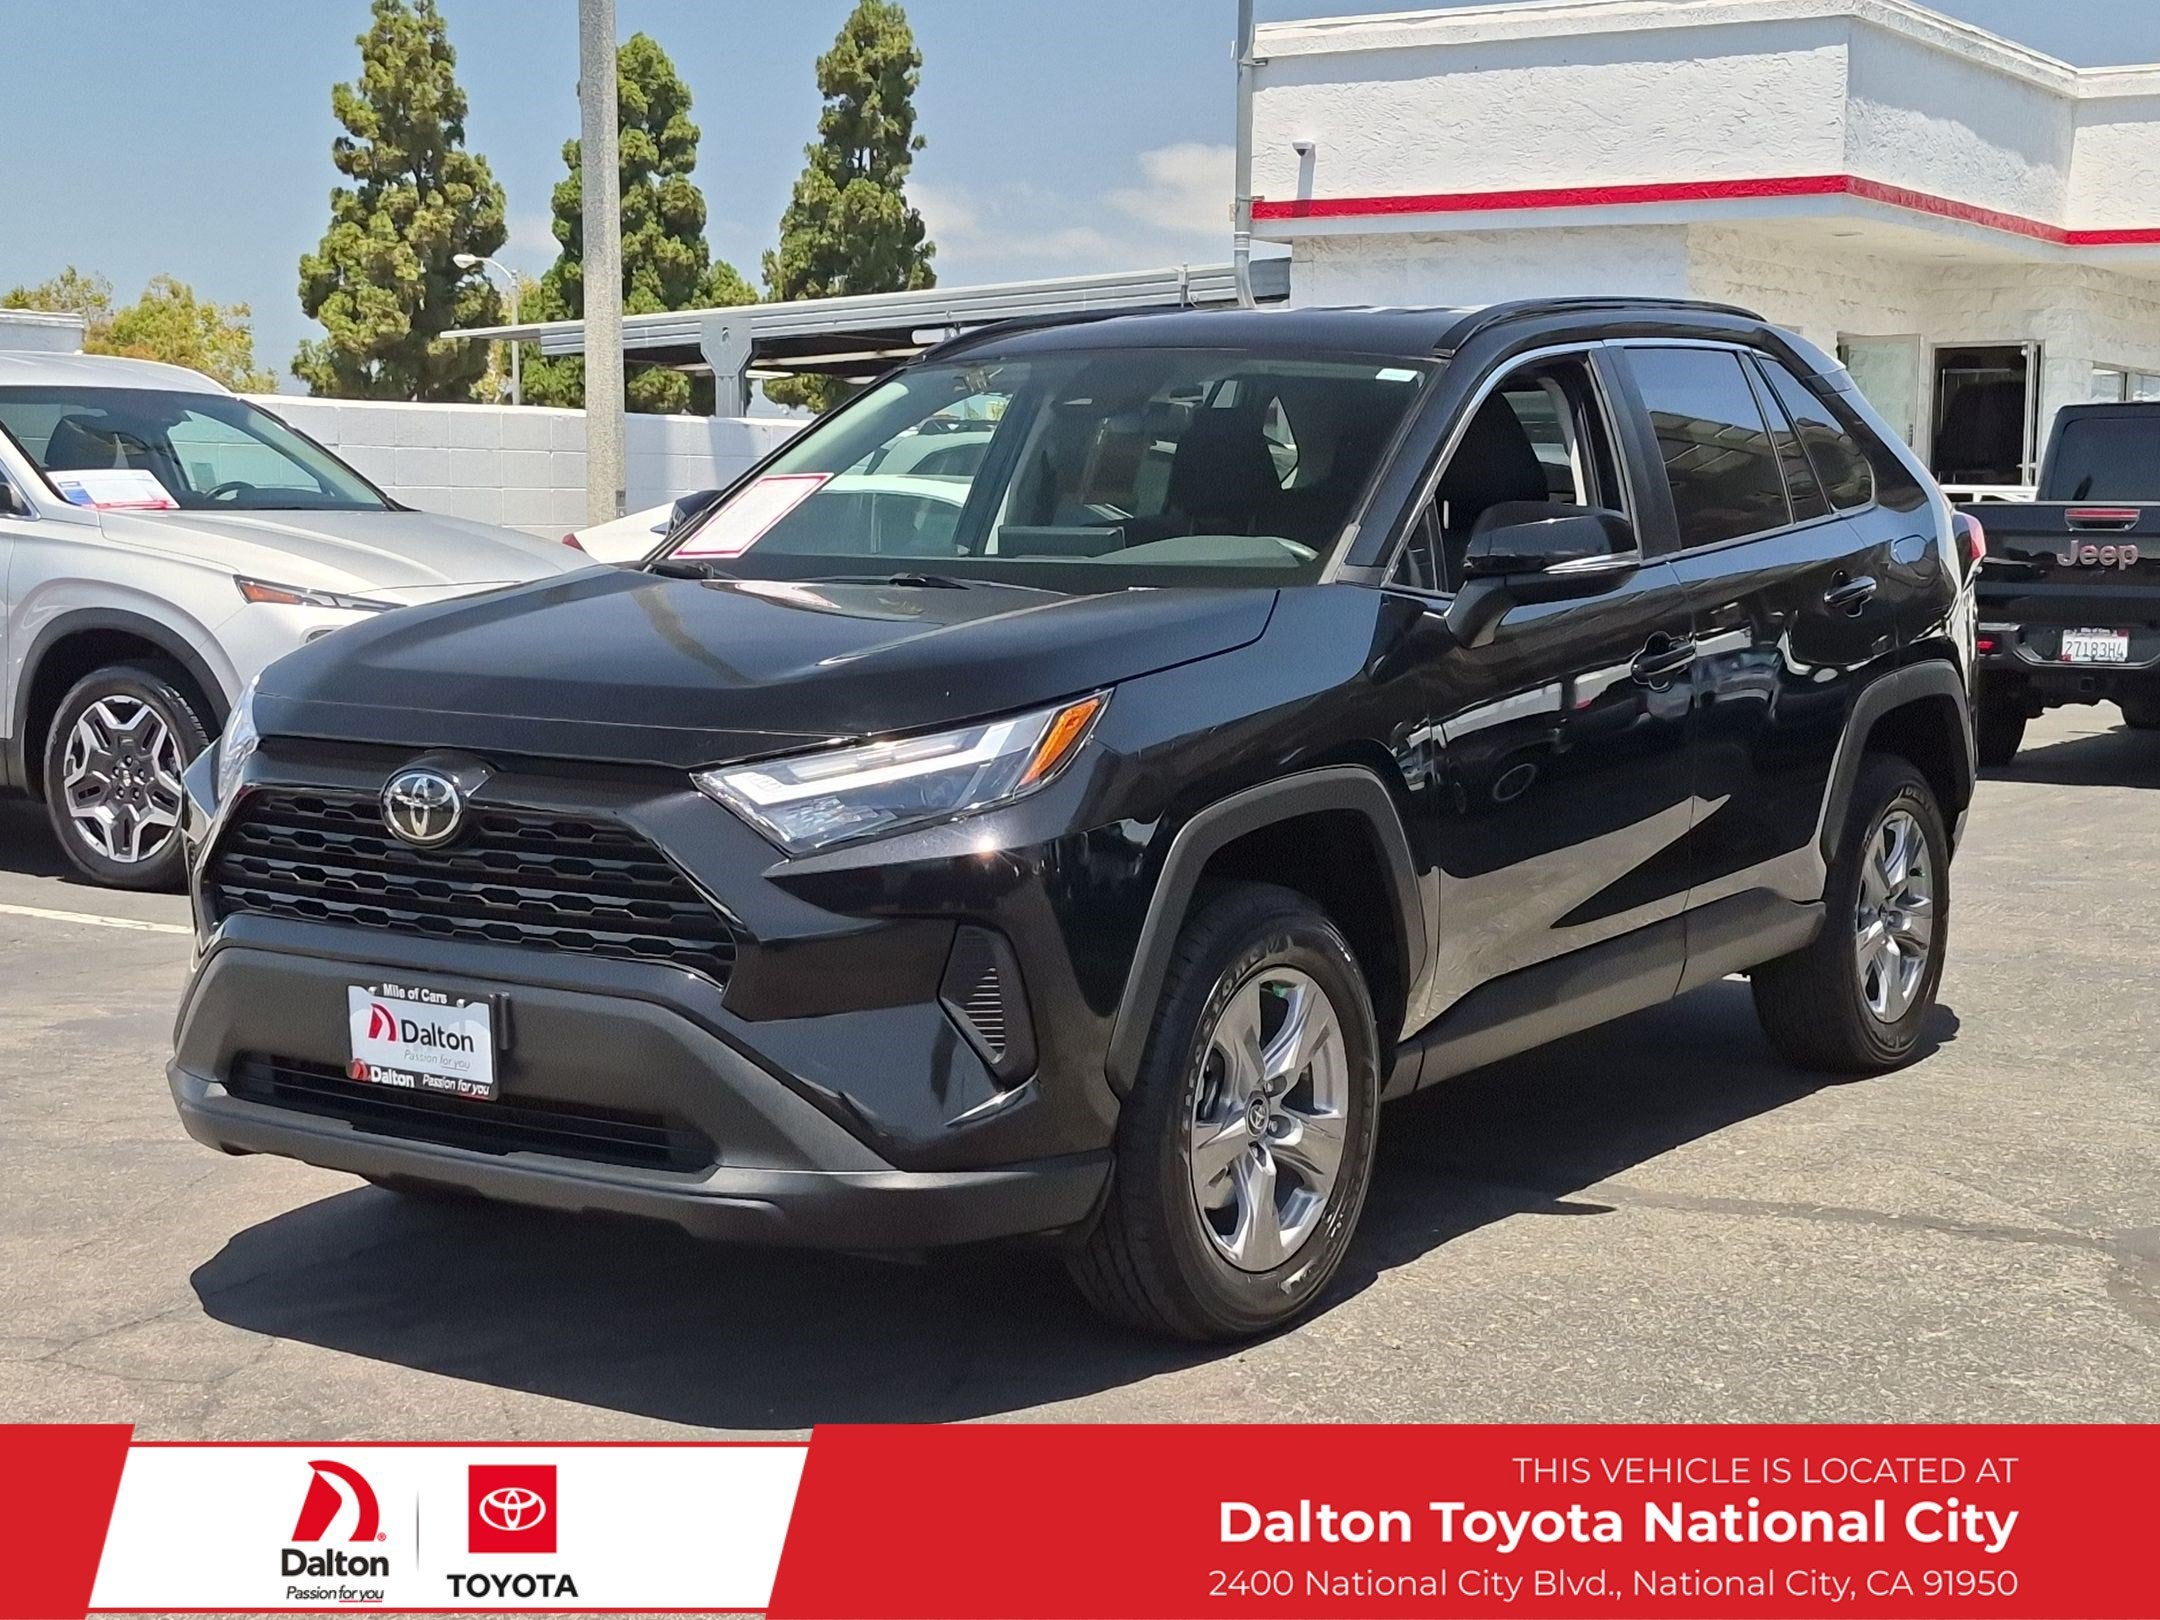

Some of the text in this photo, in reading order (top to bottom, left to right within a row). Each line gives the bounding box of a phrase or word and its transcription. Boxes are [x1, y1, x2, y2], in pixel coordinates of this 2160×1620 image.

[2056, 539, 2139, 571] Jeep
[2065, 640, 2124, 658] 27183H4
[383, 983, 448, 1004] Mile of Cars
[400, 1018, 475, 1053] Dalton
[403, 1049, 471, 1071] Passion for you
[370, 1066, 415, 1088] Dalton
[422, 1074, 491, 1096] Passion for you
